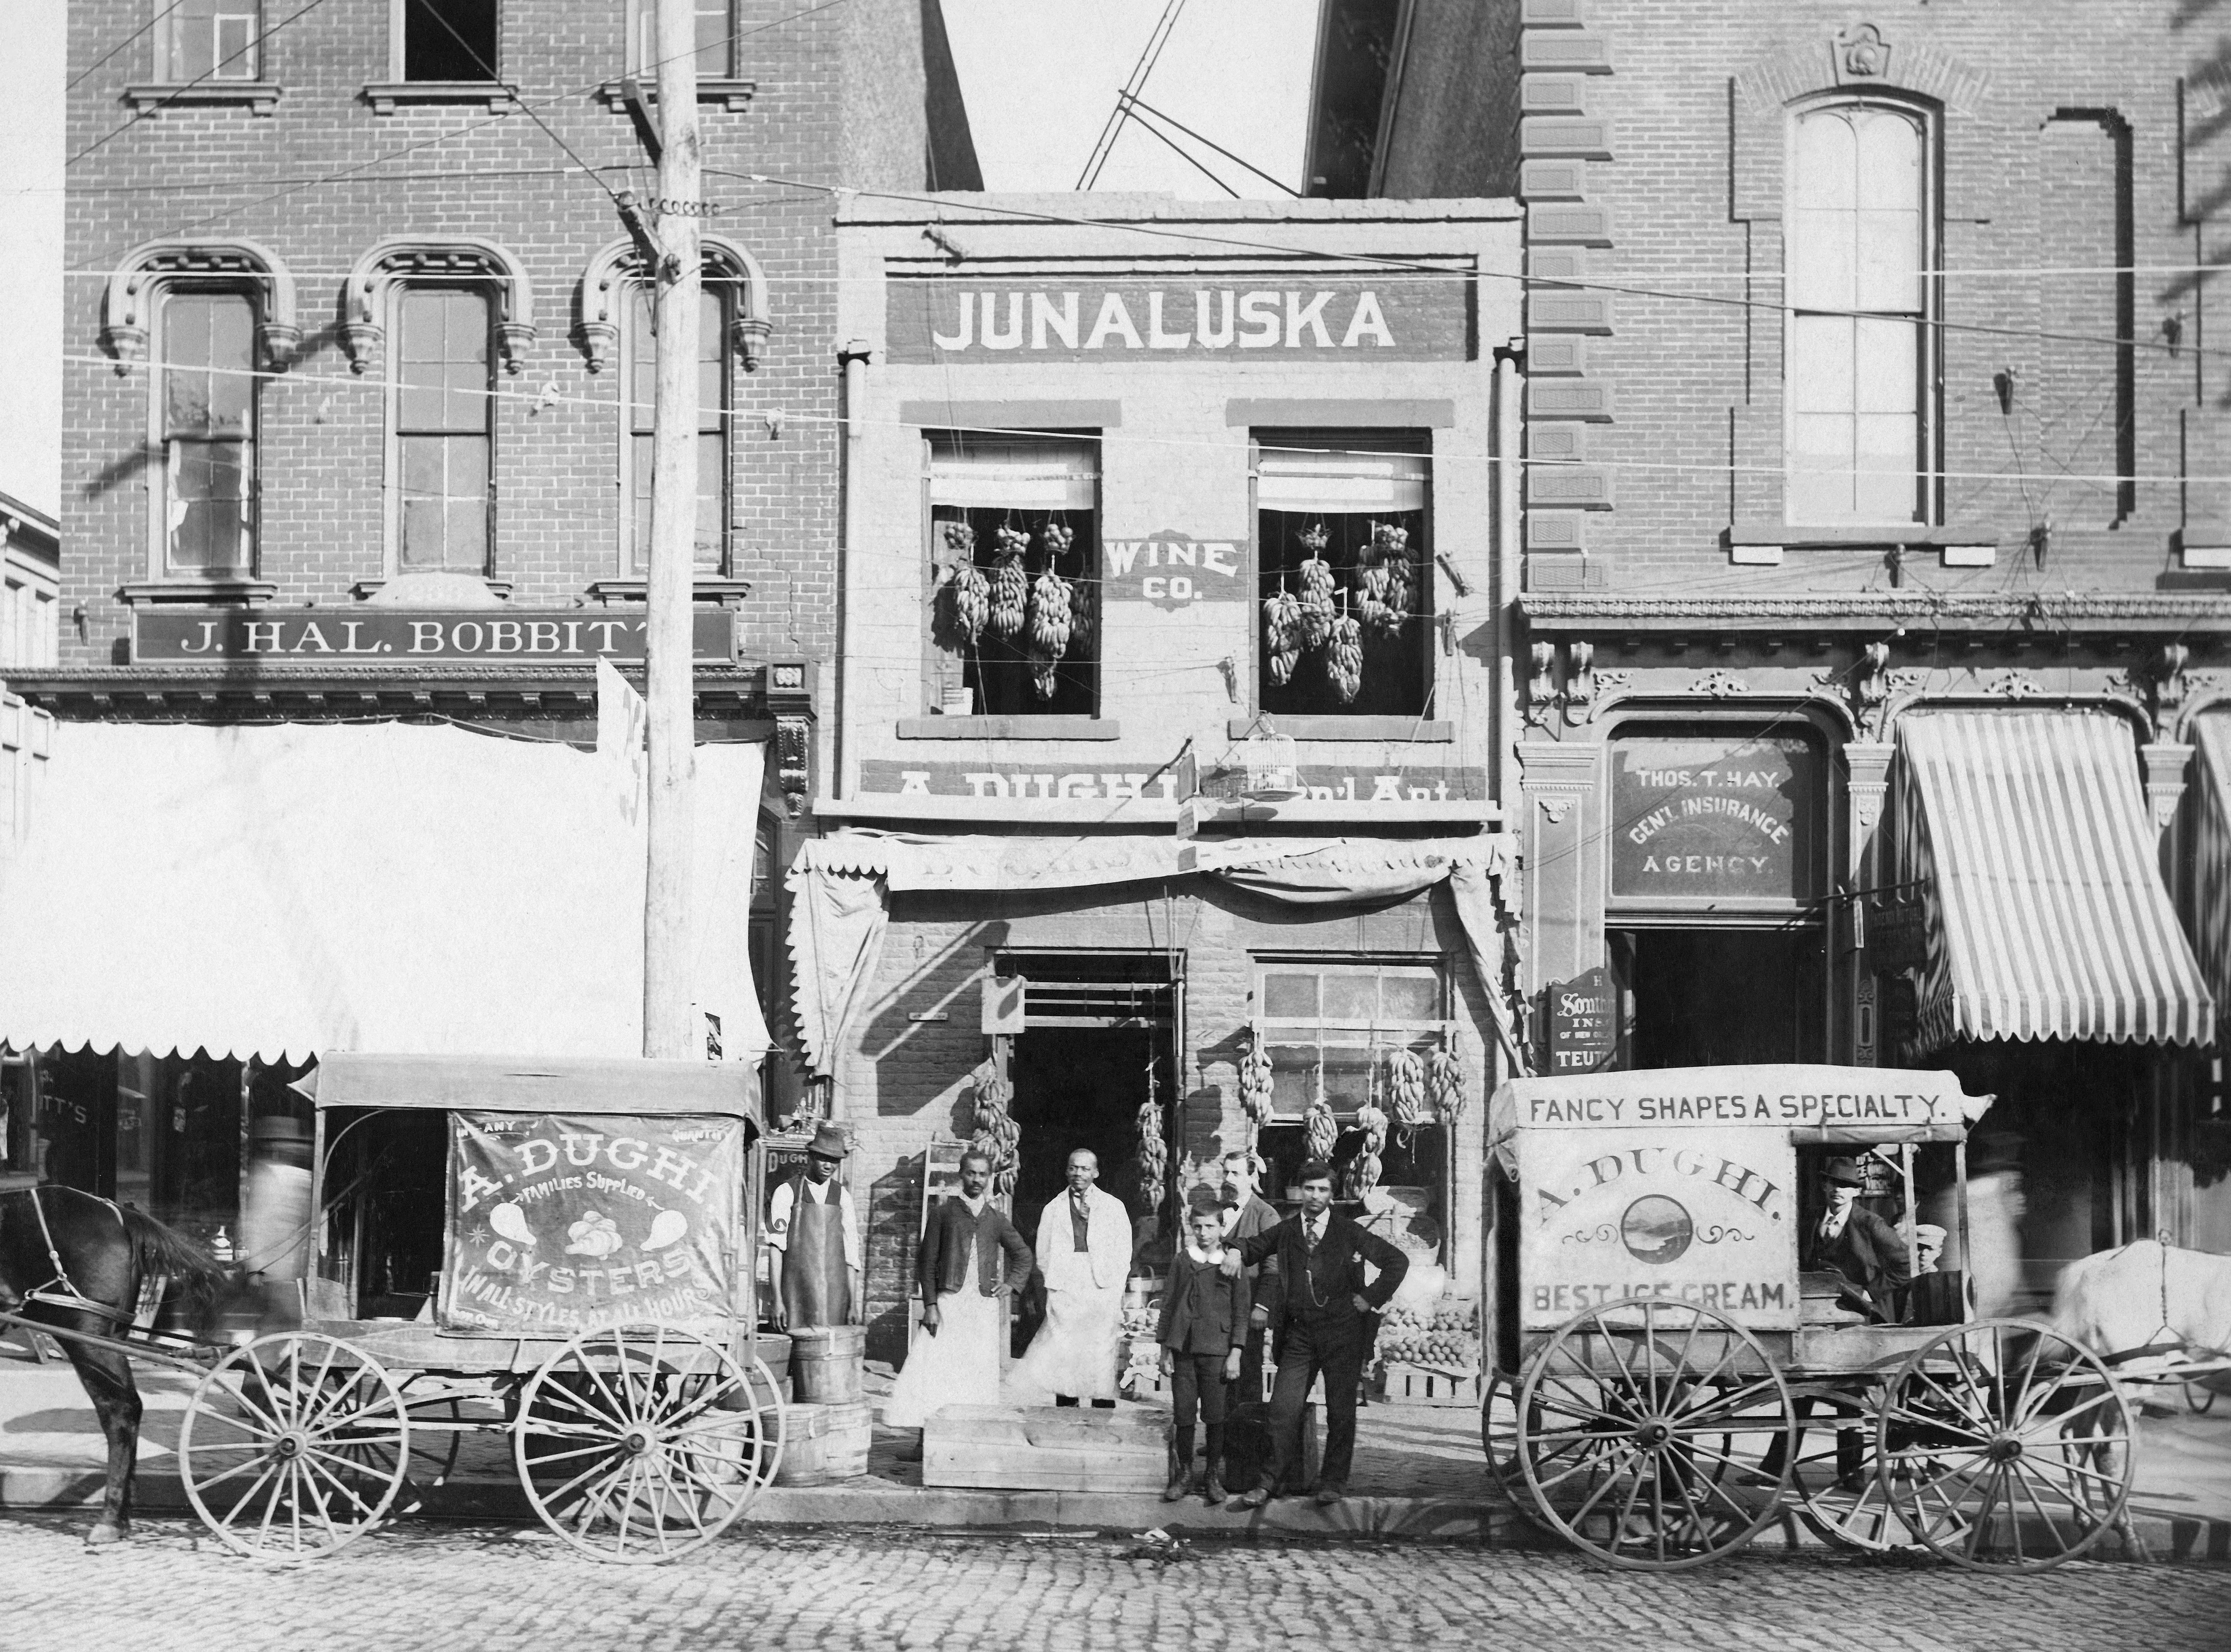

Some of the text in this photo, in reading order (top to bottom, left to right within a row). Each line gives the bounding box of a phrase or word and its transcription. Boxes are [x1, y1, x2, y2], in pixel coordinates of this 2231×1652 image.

[932, 290, 1396, 351] JUNALUSKA
[1103, 542, 1239, 578] WINE
[1142, 577, 1203, 599] CO.
[181, 621, 647, 653] J. HAL. BOBBIT
[1636, 770, 1780, 787] THOS. T. HAY.
[1681, 796, 1789, 845] INSURANCE
[1642, 855, 1774, 874] AGENCY.
[1530, 1094, 1946, 1122] FANCY SHAPES A SPECIALTY.
[484, 1121, 516, 1133] ANY
[458, 1133, 721, 1213] A. DUGHI
[767, 1151, 809, 1173] DUGH
[522, 1176, 583, 1203] FAMILIES
[1537, 1147, 1781, 1229] A. DUGHI.
[486, 1240, 693, 1296] OYSTERS
[460, 1265, 488, 1294] IN
[476, 1283, 512, 1310] ALL
[1533, 1282, 1794, 1311] BEST ICE CREAM.
